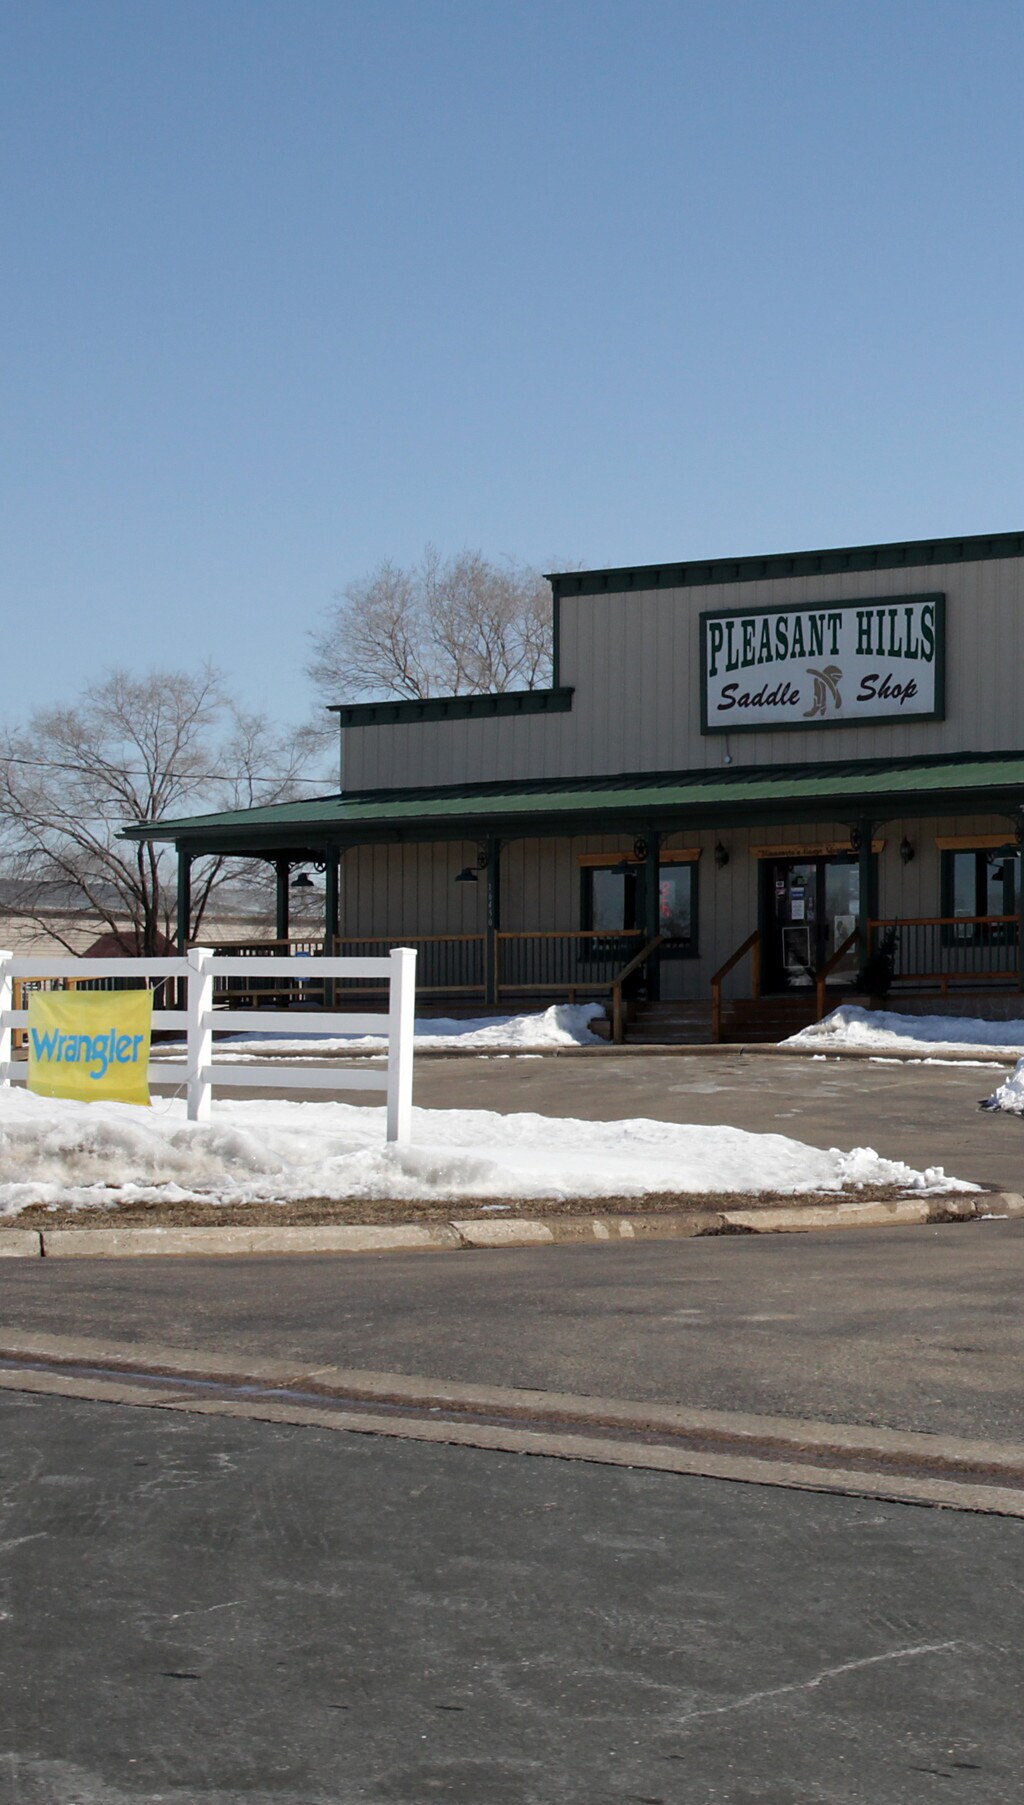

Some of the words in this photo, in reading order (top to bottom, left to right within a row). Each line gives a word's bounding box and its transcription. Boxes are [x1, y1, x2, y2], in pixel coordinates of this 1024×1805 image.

[709, 612, 842, 677] PLEASANT
[856, 605, 935, 663] HILLS
[717, 682, 800, 710] Saddle
[856, 673, 918, 705] Shop
[31, 1028, 144, 1080] Wrangler
